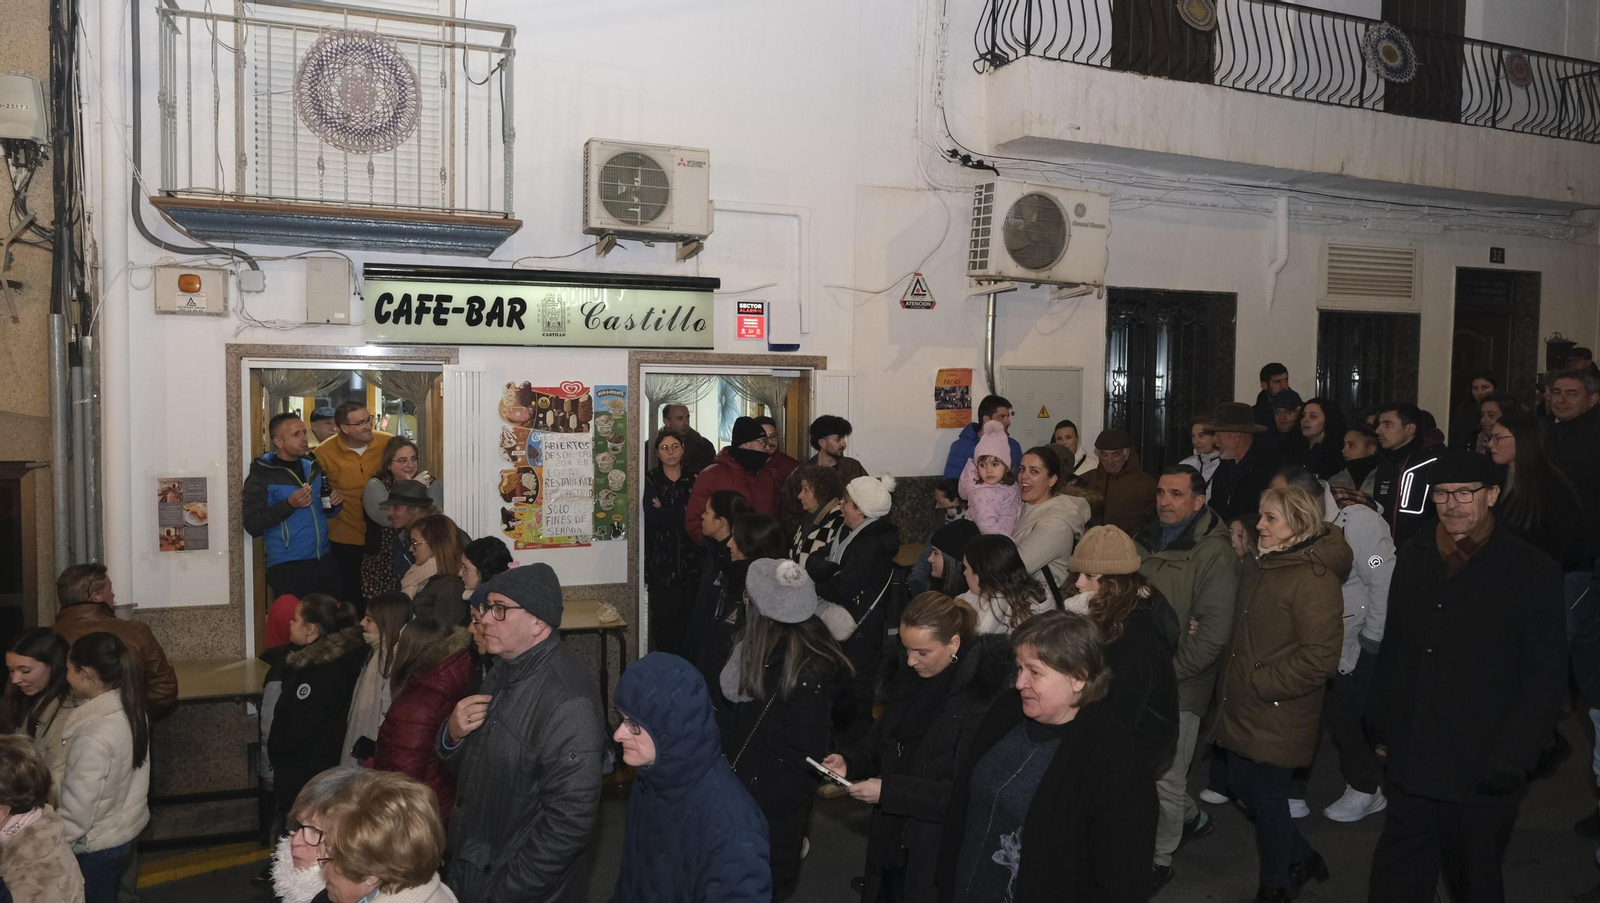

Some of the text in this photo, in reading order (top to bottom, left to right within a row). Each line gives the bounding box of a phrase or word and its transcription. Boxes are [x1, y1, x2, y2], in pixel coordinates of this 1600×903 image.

[374, 292, 527, 331] CAFE-BAR
[580, 301, 707, 333] Castillo
[545, 442, 590, 450] ABIERTOS
[545, 452, 573, 460] DESDE
[546, 504, 570, 514] SOLO
[546, 515, 588, 526] FINES DE
